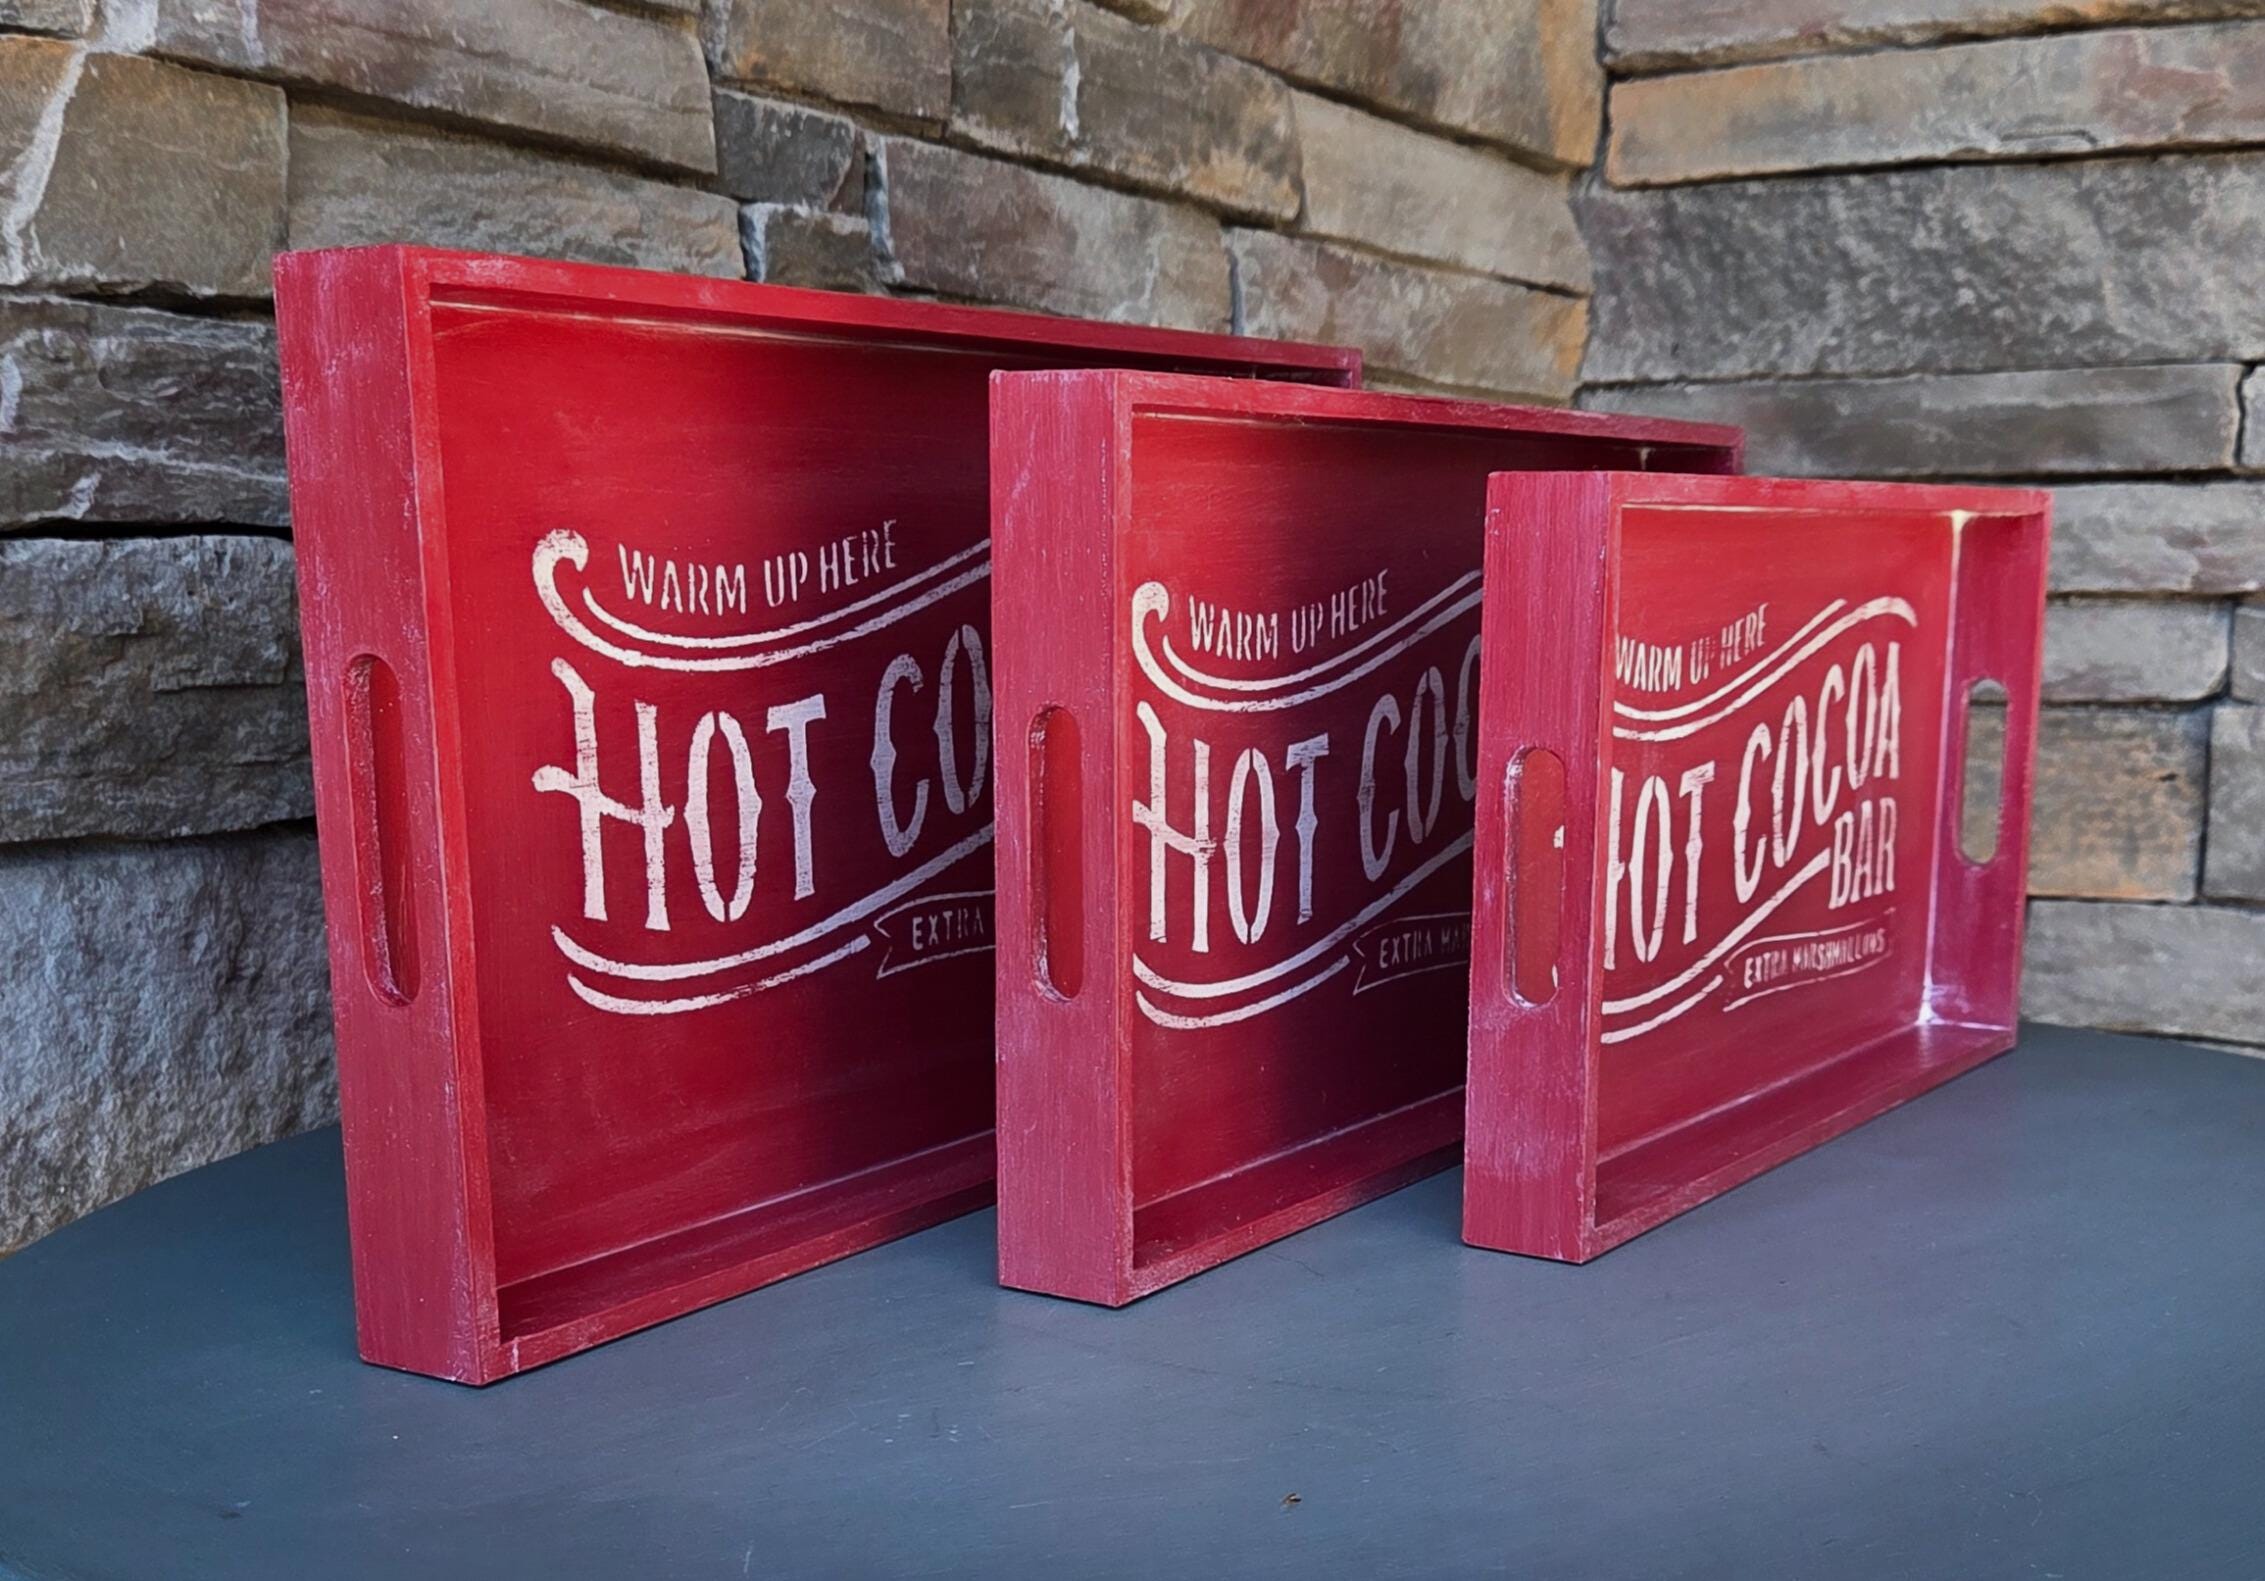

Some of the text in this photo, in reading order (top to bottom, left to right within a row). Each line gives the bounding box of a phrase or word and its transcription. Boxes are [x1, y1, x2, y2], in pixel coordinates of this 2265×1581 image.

[619, 519, 897, 616] WARM UP HERE
[1189, 568, 1390, 662] WARM UP HERE
[1615, 634, 1683, 693] WARM
[1720, 601, 1769, 670] HERE
[532, 656, 827, 932] HOT
[1733, 641, 1901, 904] COCOA
[1132, 700, 1330, 953] HOT
[1829, 797, 1896, 910] BAR
[911, 904, 985, 951] EXTRA
[1379, 928, 1433, 969] EXTRA
[1743, 948, 1787, 989] EXTRA
